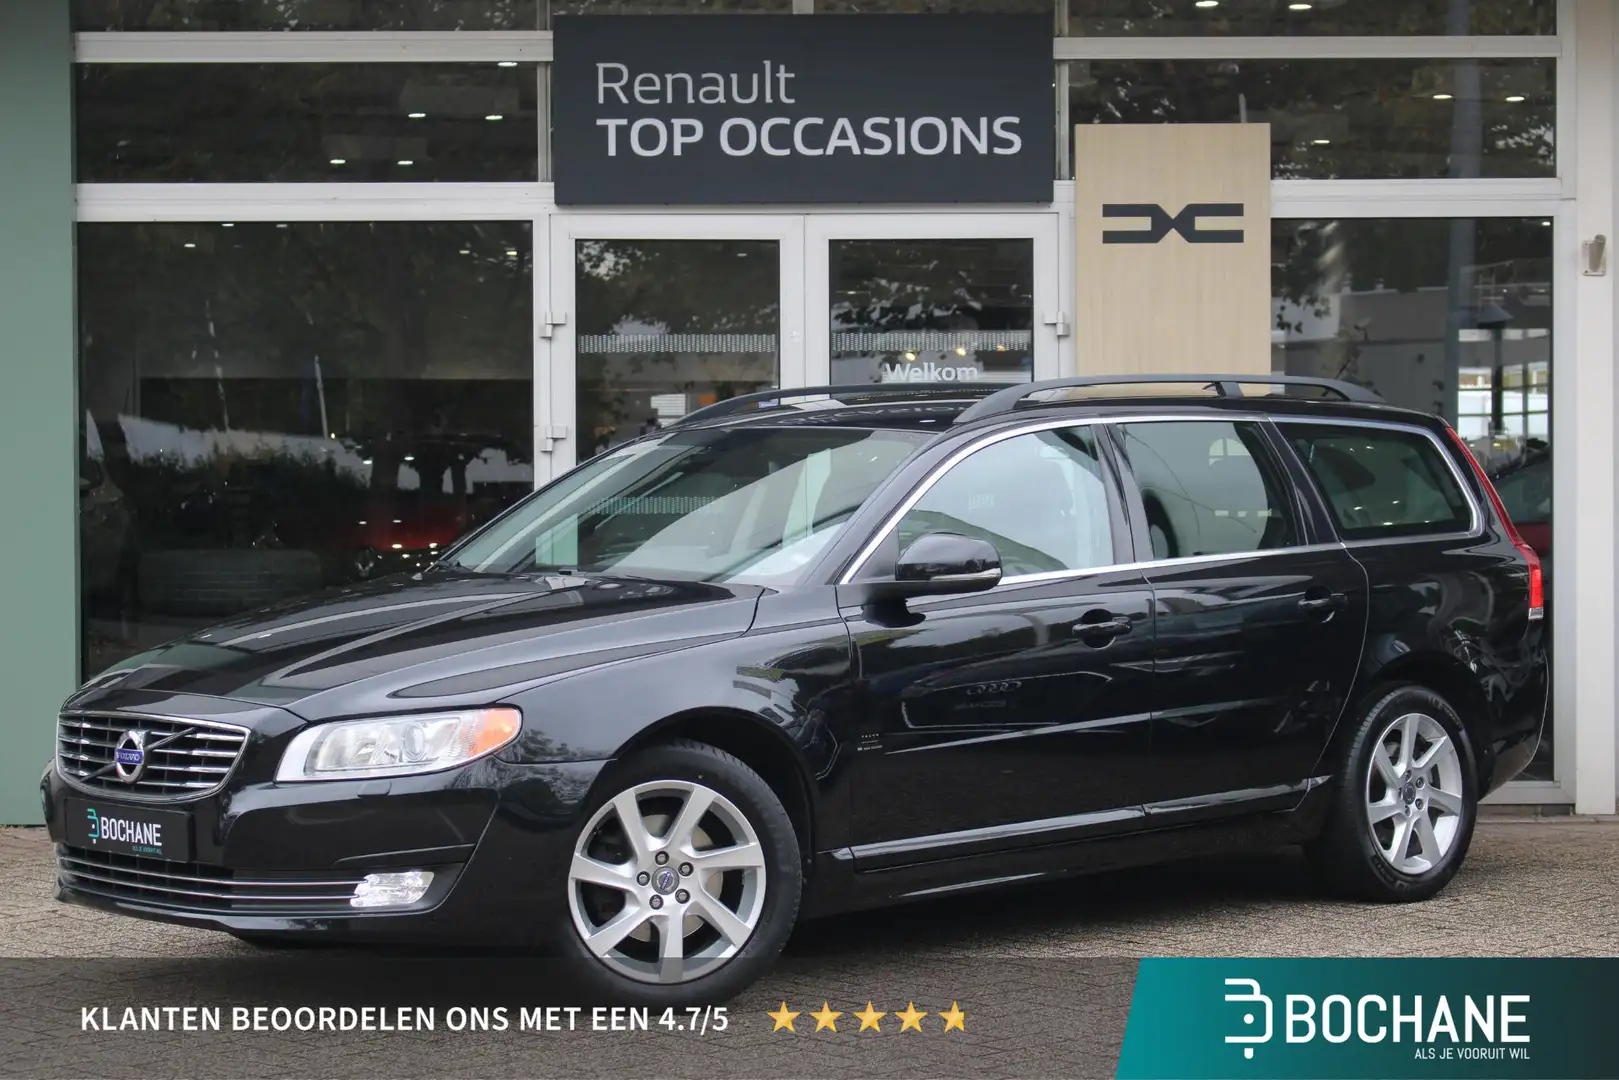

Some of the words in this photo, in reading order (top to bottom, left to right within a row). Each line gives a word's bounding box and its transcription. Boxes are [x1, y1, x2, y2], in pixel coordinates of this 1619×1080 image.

[596, 61, 796, 104] Renault
[596, 118, 704, 157] TOP
[719, 116, 1022, 157] OCCASIONS
[885, 362, 978, 381] Welkom
[115, 751, 141, 762] VOLVO
[100, 816, 163, 847] BOCHANE
